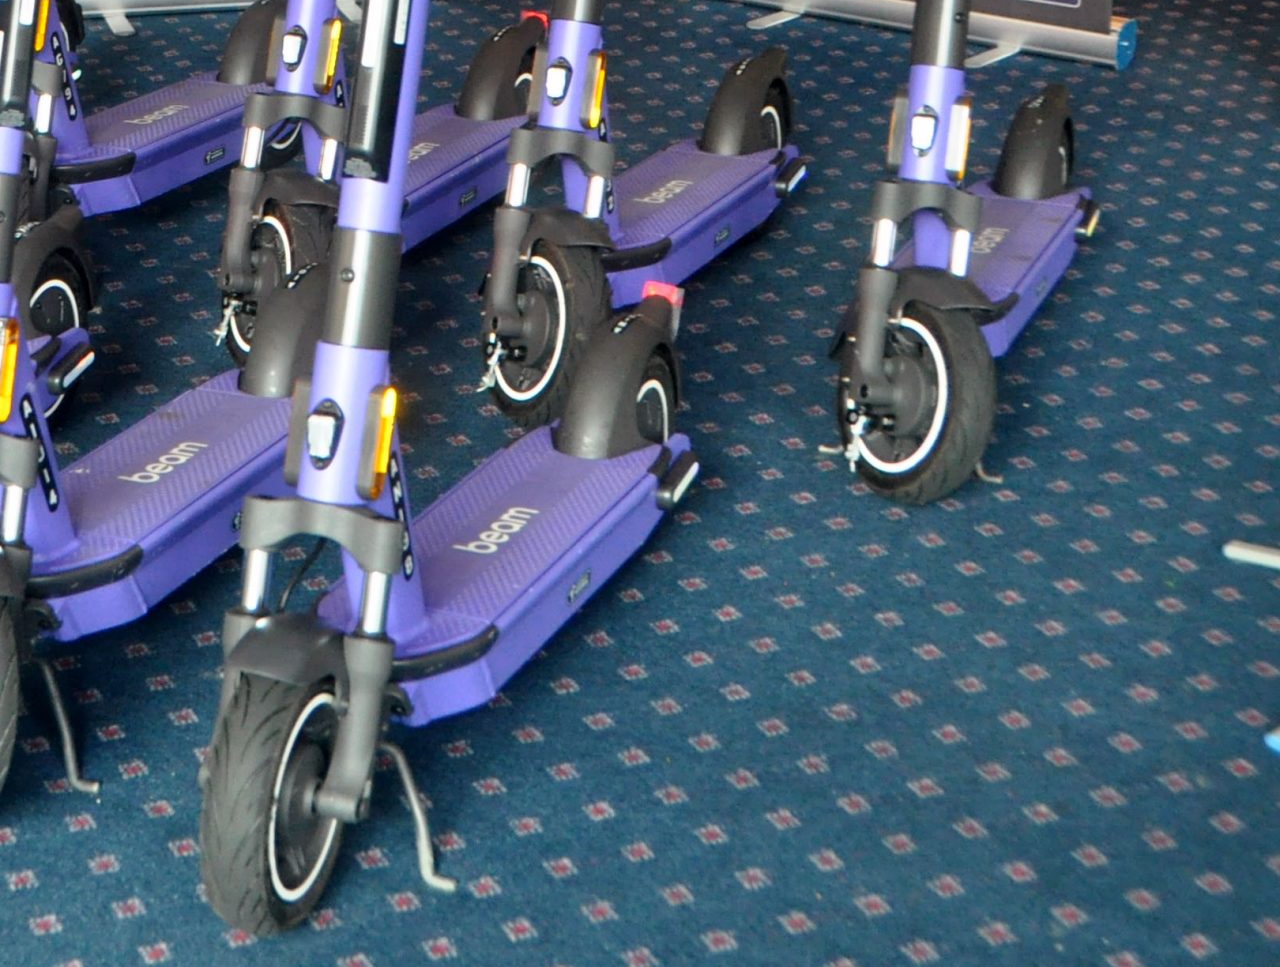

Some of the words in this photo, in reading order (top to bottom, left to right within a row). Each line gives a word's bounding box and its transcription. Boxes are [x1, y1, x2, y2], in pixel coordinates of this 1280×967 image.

[633, 178, 693, 203] beam
[118, 441, 208, 485] beam
[453, 506, 540, 555] beam
